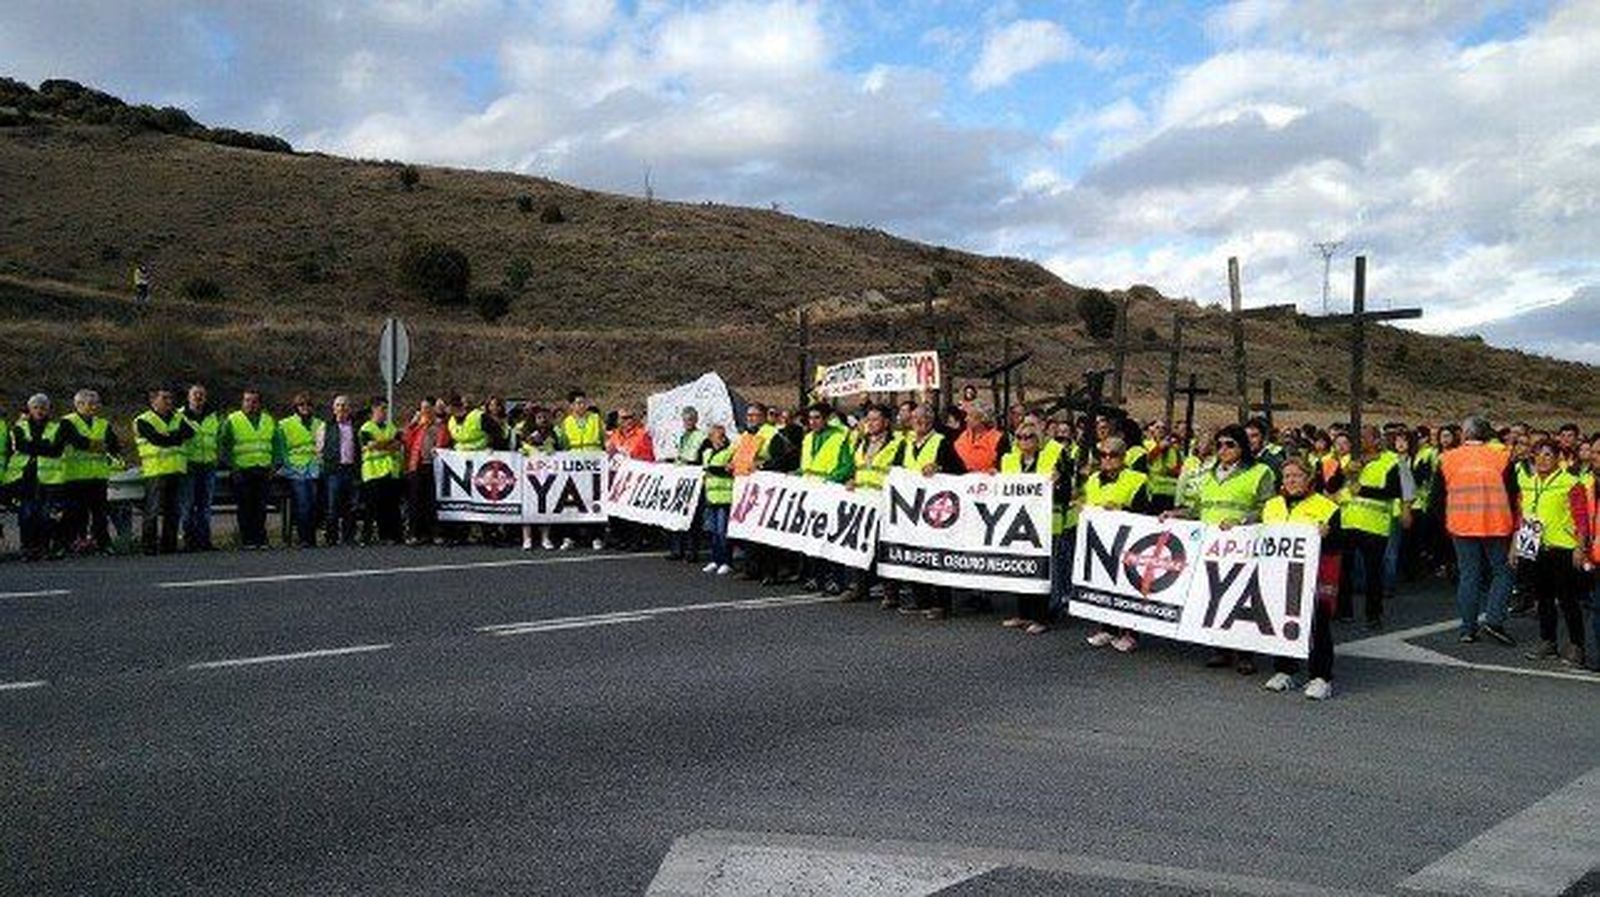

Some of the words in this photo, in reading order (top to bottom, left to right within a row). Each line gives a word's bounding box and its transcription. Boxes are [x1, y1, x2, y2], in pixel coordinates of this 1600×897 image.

[914, 356, 936, 385] YA
[441, 459, 517, 502] NO
[562, 460, 601, 472] LIBRE
[526, 473, 601, 514] YA!
[890, 485, 960, 529] NO
[1003, 483, 1043, 497] LIBRE
[765, 488, 828, 539] Libre
[827, 500, 876, 553] YA!
[974, 503, 1043, 549] YA
[1083, 520, 1187, 597] NO
[1252, 537, 1307, 559] LIBRE
[1520, 534, 1536, 554] YA
[1202, 561, 1304, 641] YA!
